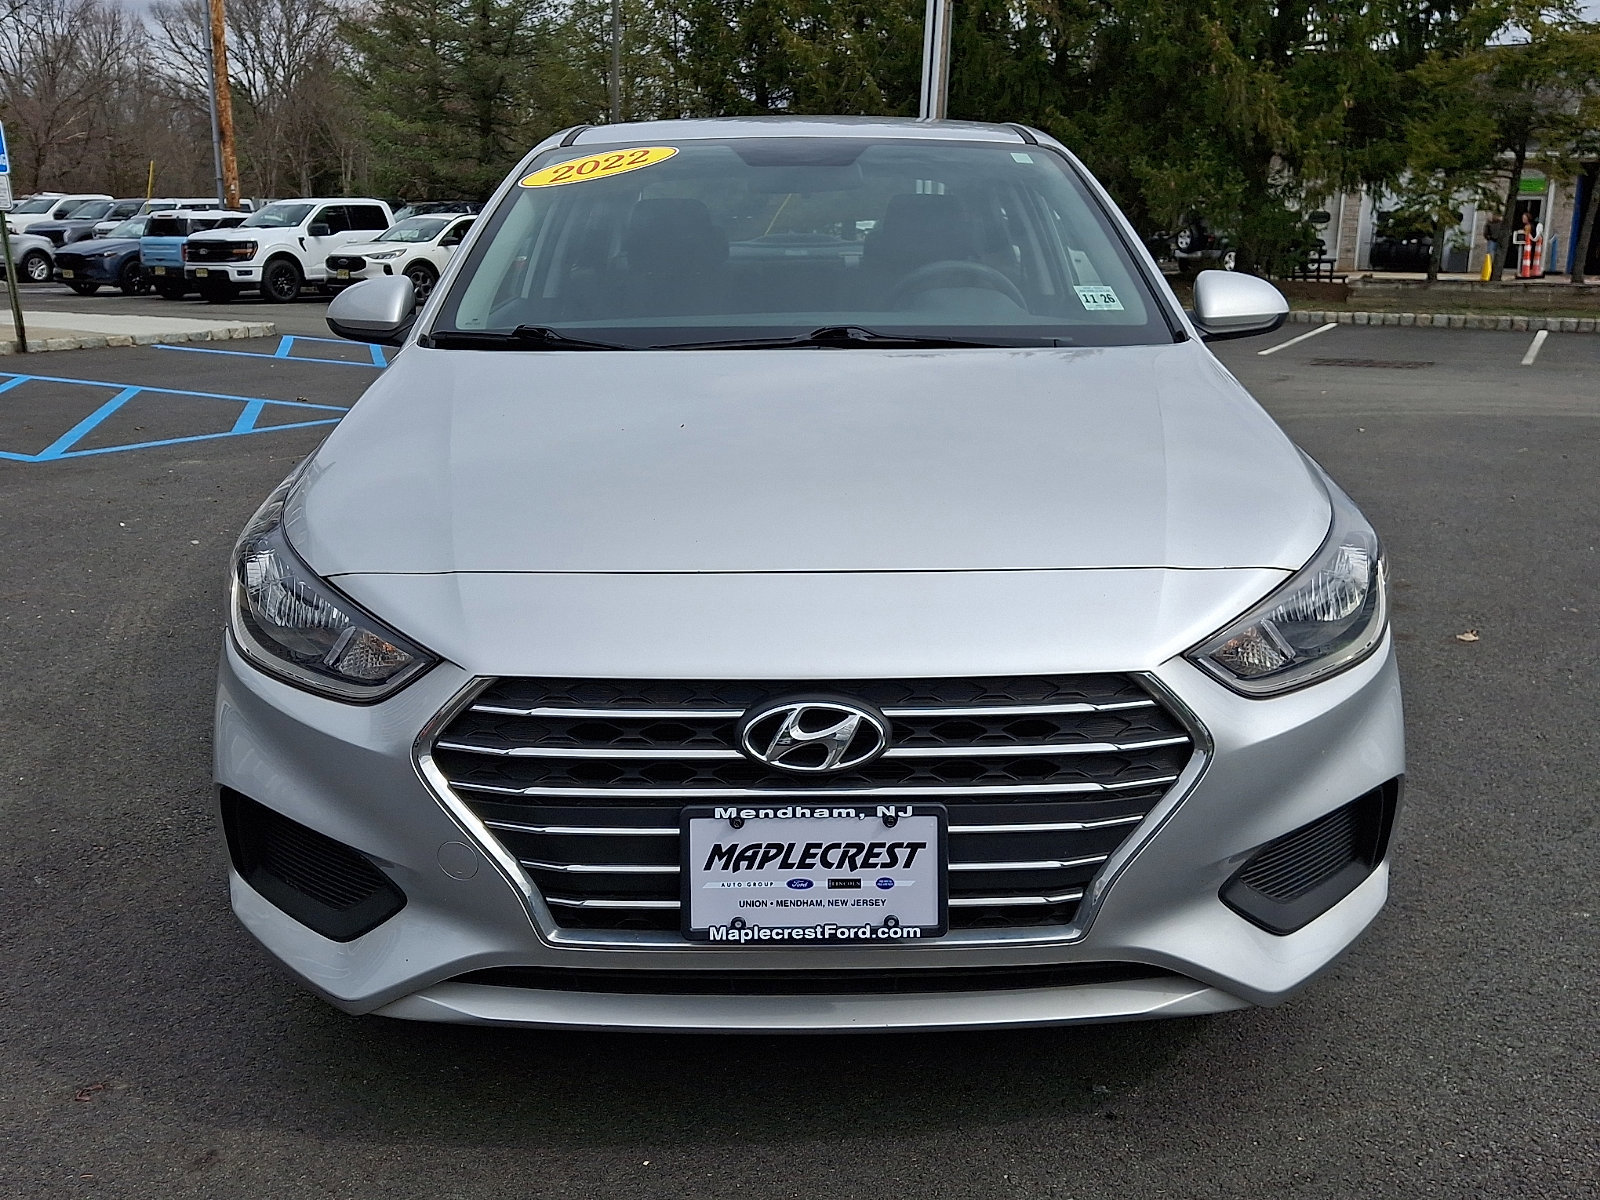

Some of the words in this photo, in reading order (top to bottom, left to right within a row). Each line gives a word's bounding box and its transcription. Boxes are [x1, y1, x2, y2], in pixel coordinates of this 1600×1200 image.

[549, 150, 650, 183] 2022
[1082, 294, 1098, 304] 11
[1100, 294, 1116, 304] 26
[714, 806, 865, 820] Mendham,
[876, 805, 913, 818] NJ
[703, 841, 927, 873] MAPLECREST
[739, 899, 767, 908] UNION
[776, 899, 825, 908] MENDHAM,
[828, 898, 849, 907] NEW
[850, 898, 887, 907] JERSEY
[709, 925, 921, 943] MaplecrestFord.com
